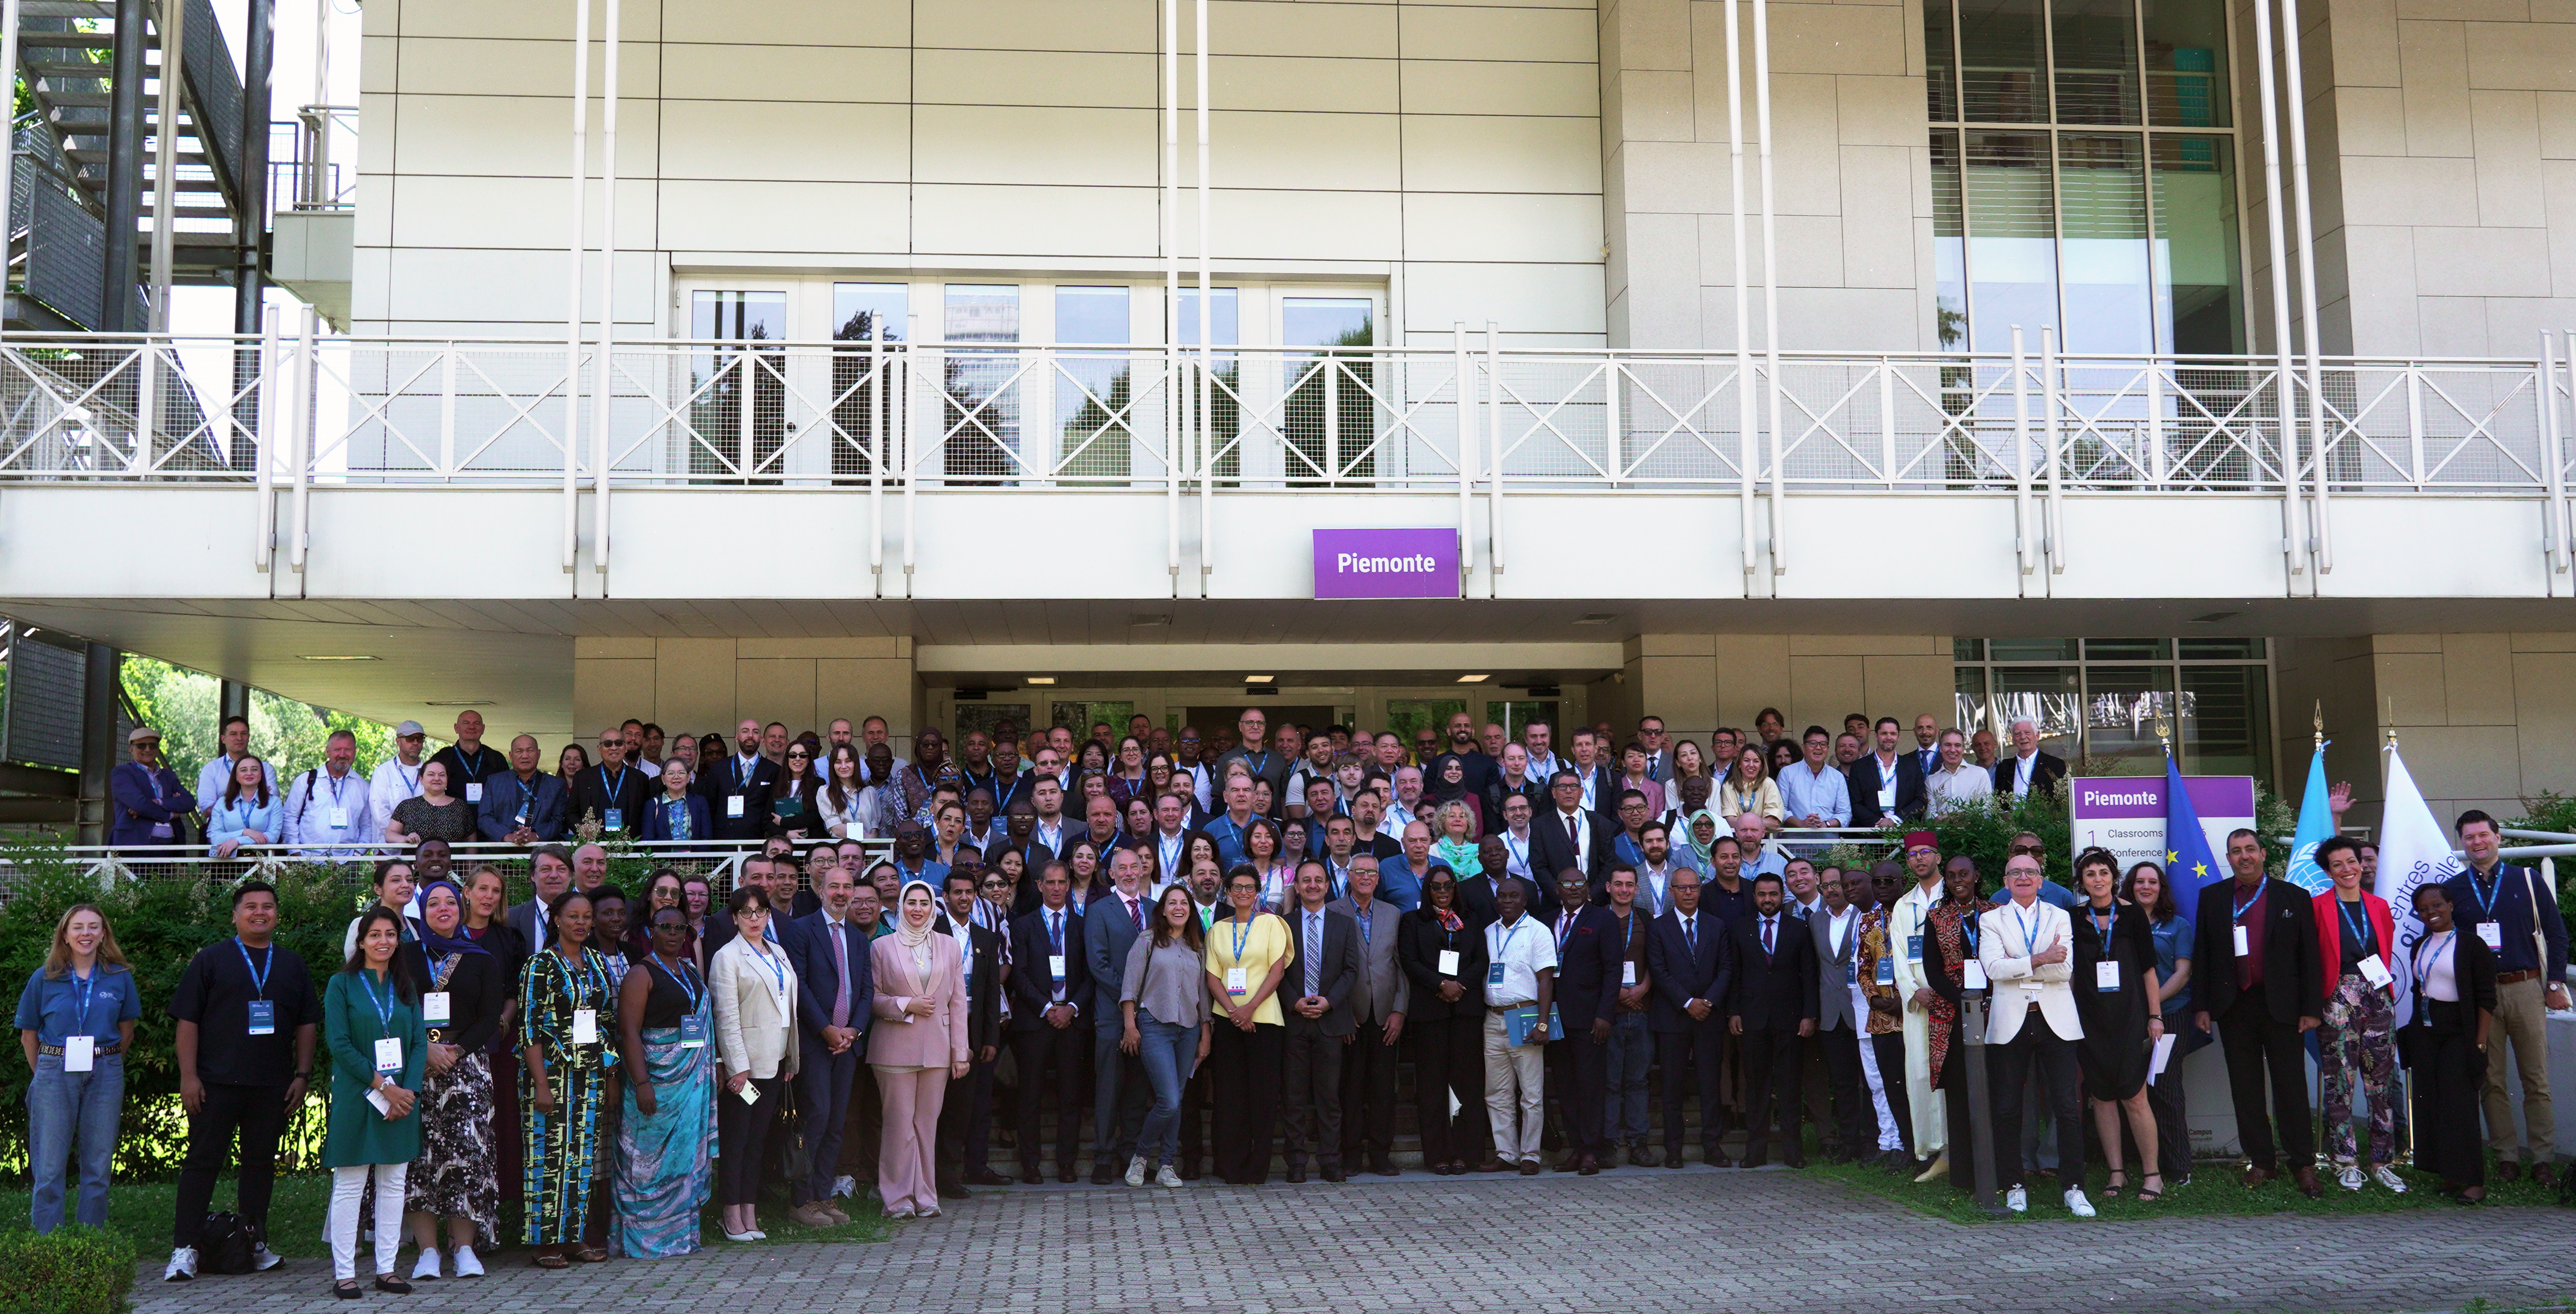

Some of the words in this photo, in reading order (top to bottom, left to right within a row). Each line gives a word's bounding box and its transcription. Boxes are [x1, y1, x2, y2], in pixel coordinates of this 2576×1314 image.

[1337, 552, 1436, 573] Piemonte
[2084, 791, 2158, 806] Piemonte
[2108, 829, 2163, 838] Classrooms
[2389, 860, 2430, 932] entres
[2400, 922, 2420, 948] of
